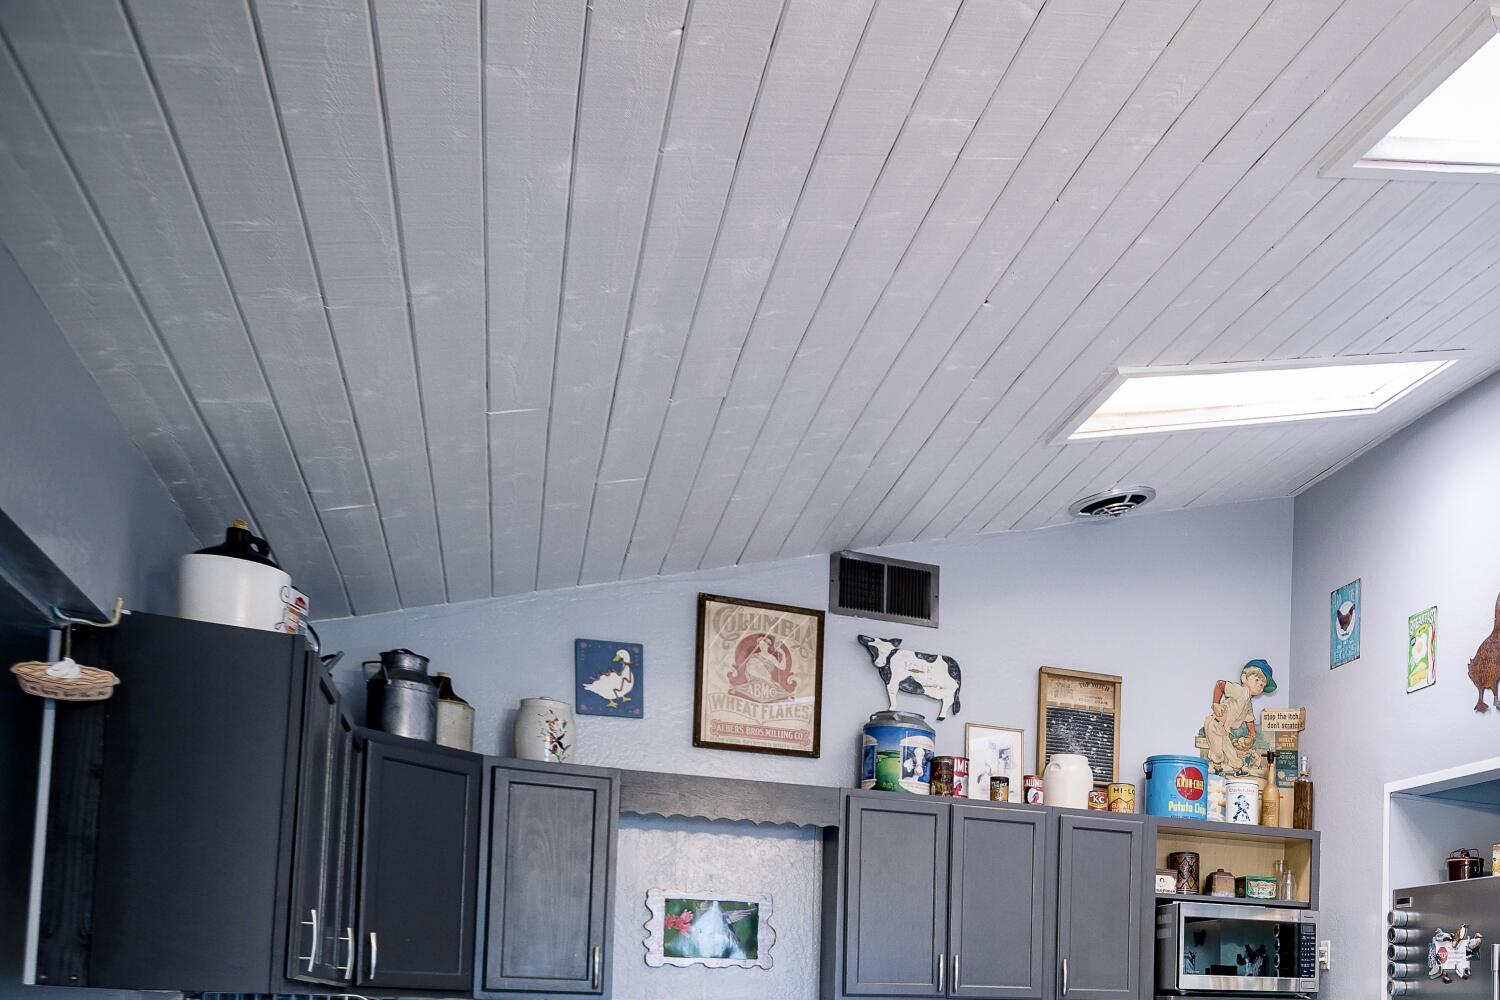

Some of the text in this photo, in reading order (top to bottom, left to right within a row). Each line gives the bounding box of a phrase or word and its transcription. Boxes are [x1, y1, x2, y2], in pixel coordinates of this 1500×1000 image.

[711, 694, 810, 720] WHEAT FLAKES
[716, 721, 744, 734] ALBERS
[765, 728, 793, 739] MILLING
[1092, 794, 1105, 803] KC
[1168, 801, 1193, 812] Potato
